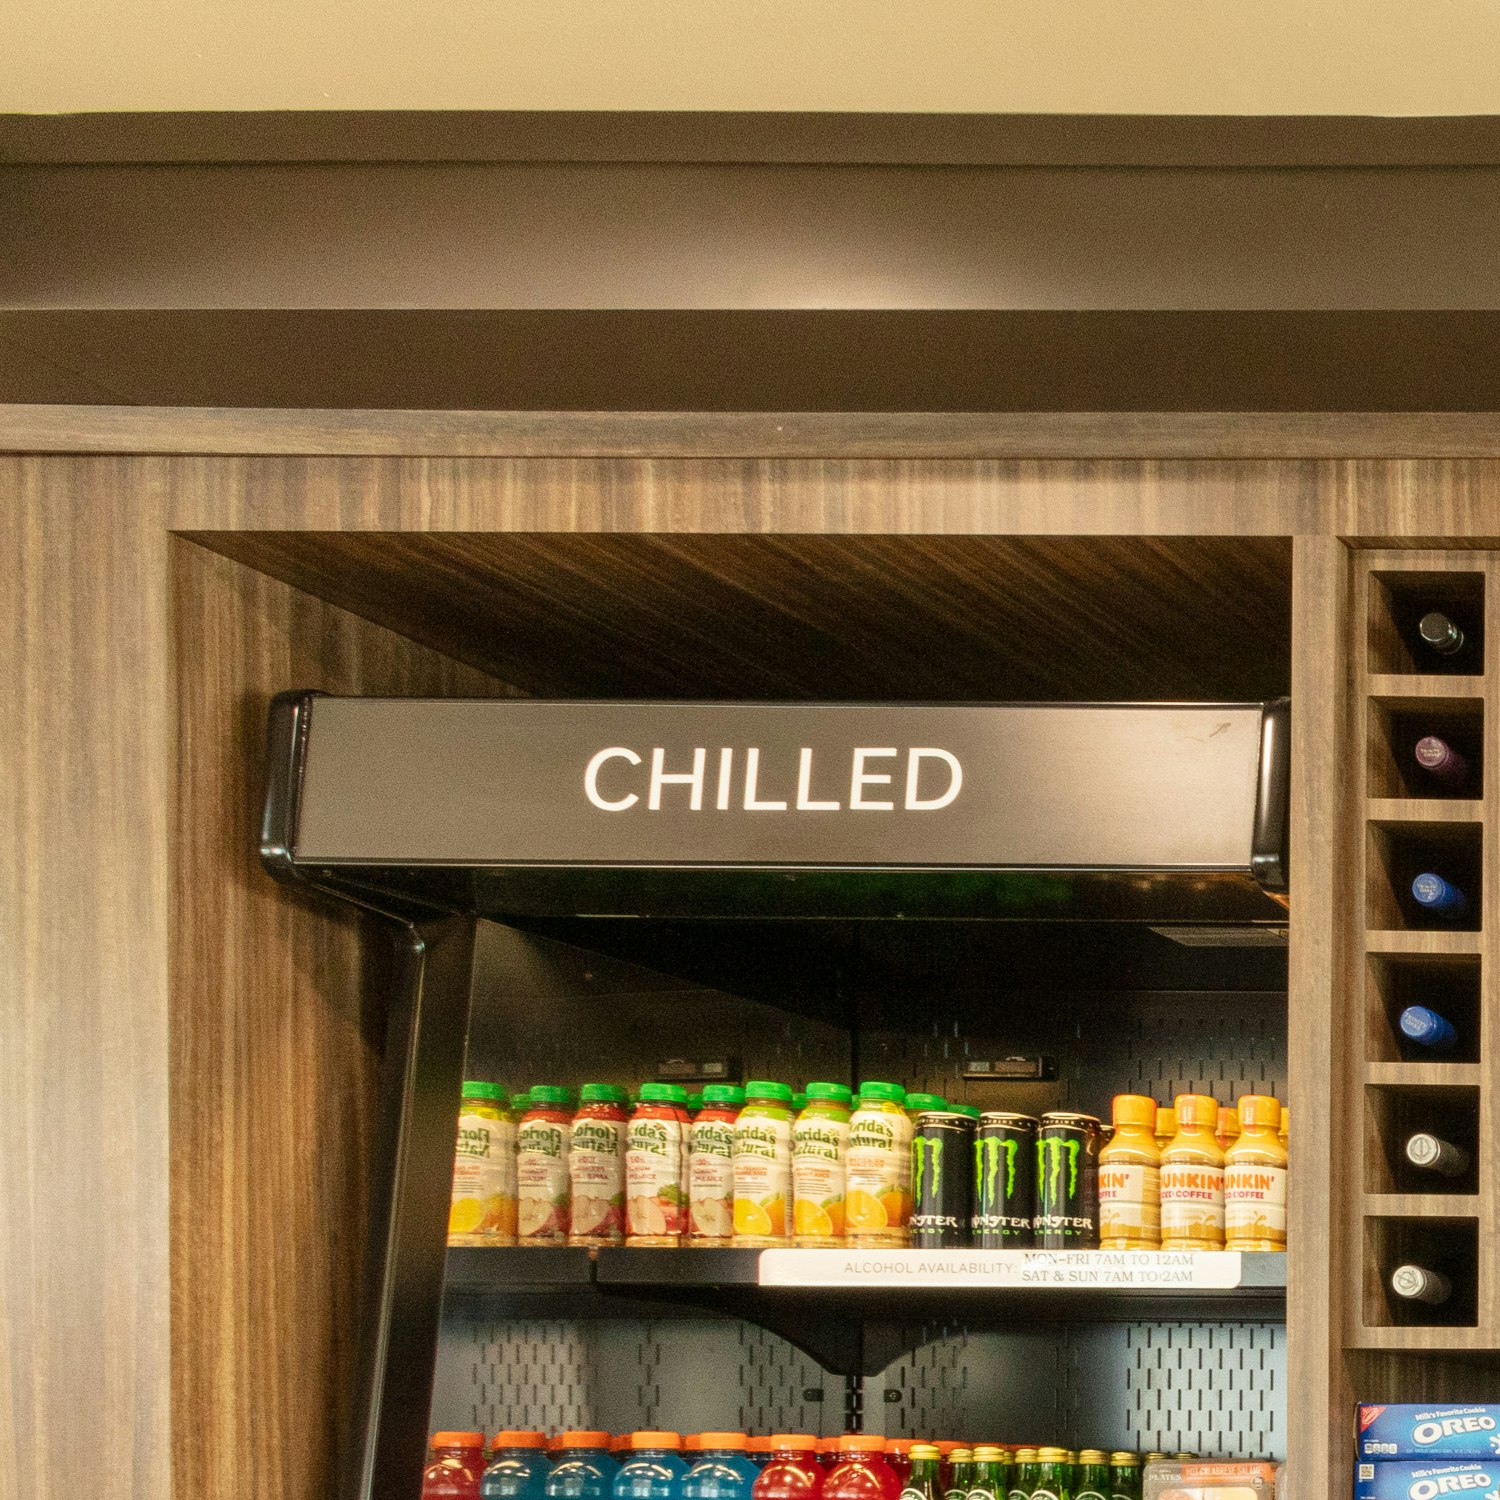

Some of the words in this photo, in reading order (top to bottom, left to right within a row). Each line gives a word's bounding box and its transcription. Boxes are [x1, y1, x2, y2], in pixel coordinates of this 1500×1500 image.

[584, 747, 962, 811] CHILLED
[1096, 1254, 1124, 1265] 7AM
[1132, 1254, 1149, 1264] TO
[1156, 1254, 1193, 1265] 12AM
[844, 1263, 912, 1273] ALCOHOL
[919, 1263, 1017, 1273] AVAILABILITY:
[1022, 1271, 1048, 1281] SAT
[1053, 1271, 1064, 1281] &
[1069, 1272, 1098, 1281] SUN
[1105, 1272, 1133, 1282] 7AM
[1140, 1272, 1158, 1282] TO
[1436, 1409, 1462, 1418] Favorite
[1464, 1407, 1485, 1415] Cookie
[1412, 1416, 1496, 1446] OREO
